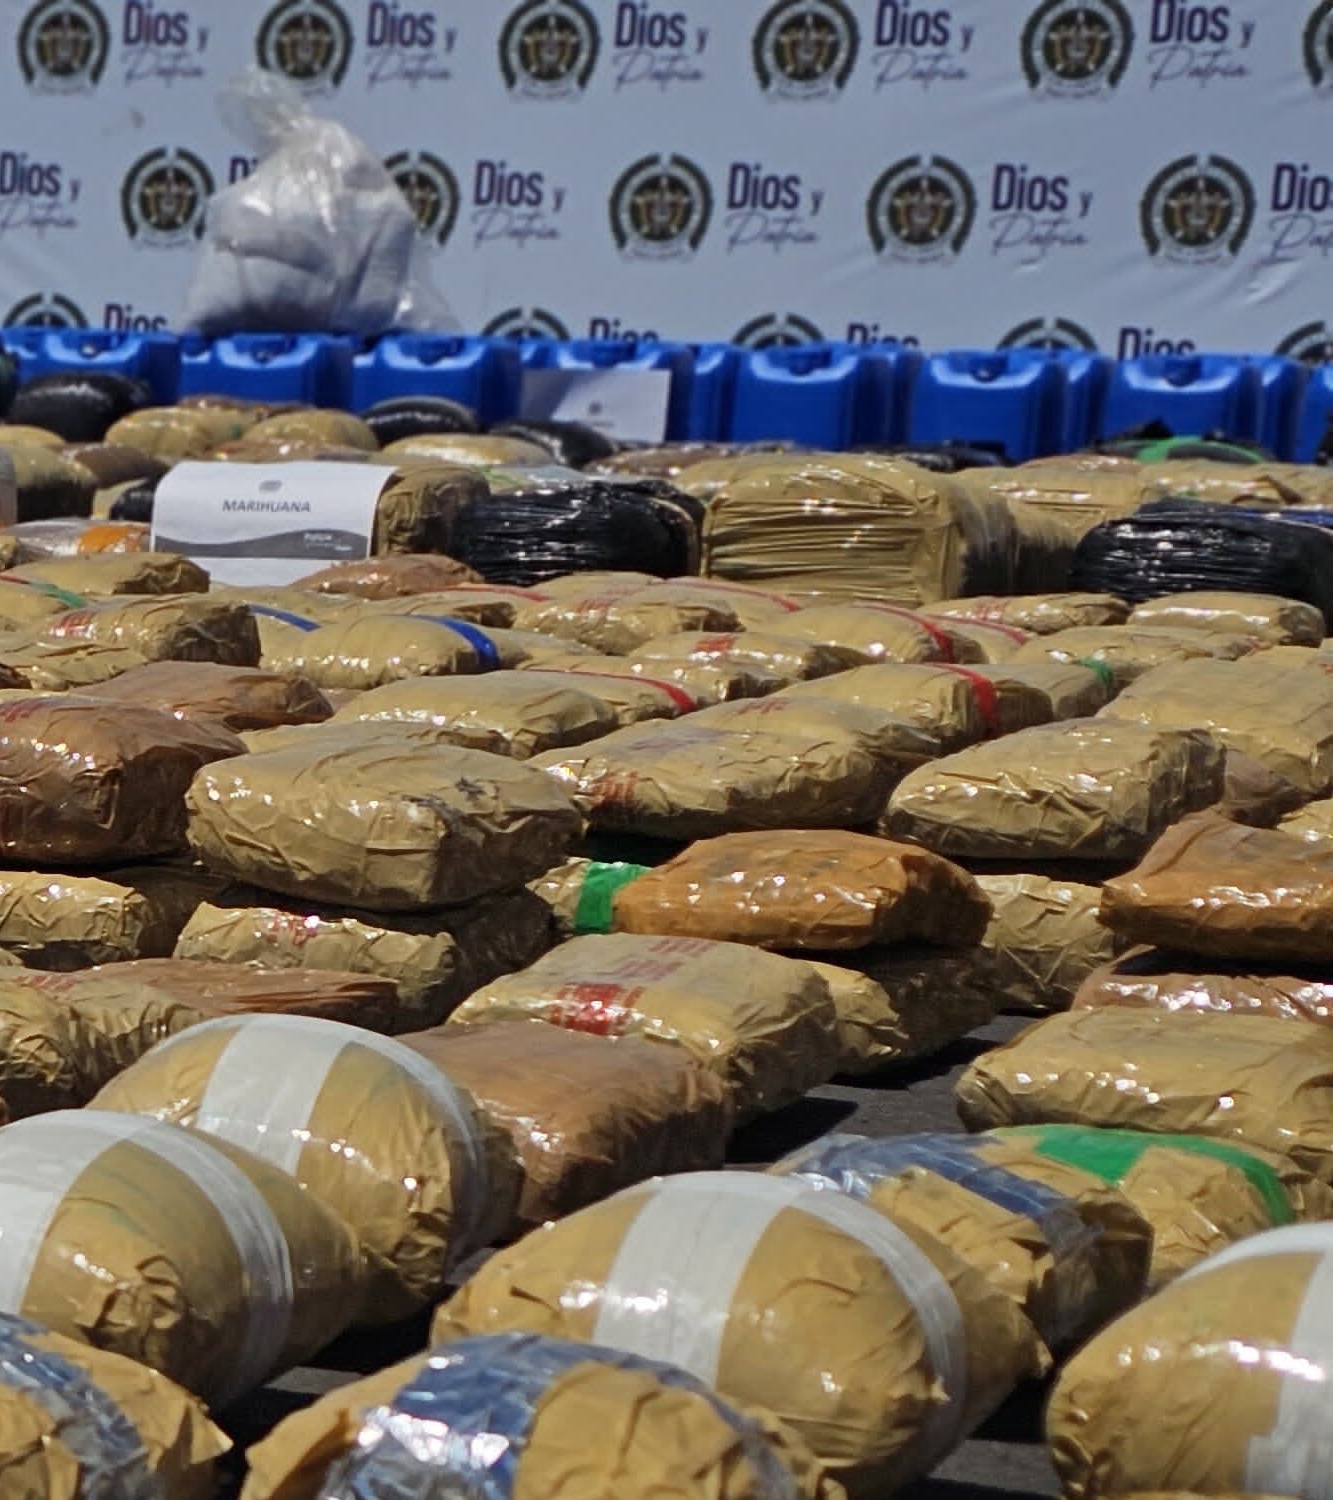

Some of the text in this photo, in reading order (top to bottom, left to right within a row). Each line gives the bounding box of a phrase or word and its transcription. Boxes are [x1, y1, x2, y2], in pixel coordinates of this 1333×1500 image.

[123, 0, 189, 46] Dios
[367, 0, 436, 48] Dios
[614, 0, 686, 48] Dios
[874, 0, 951, 47] Dios
[1149, 0, 1229, 44] Dios
[473, 160, 544, 207] Dios
[727, 162, 801, 210] Dios
[992, 164, 1069, 212] Dios
[1271, 163, 1333, 213] Dio
